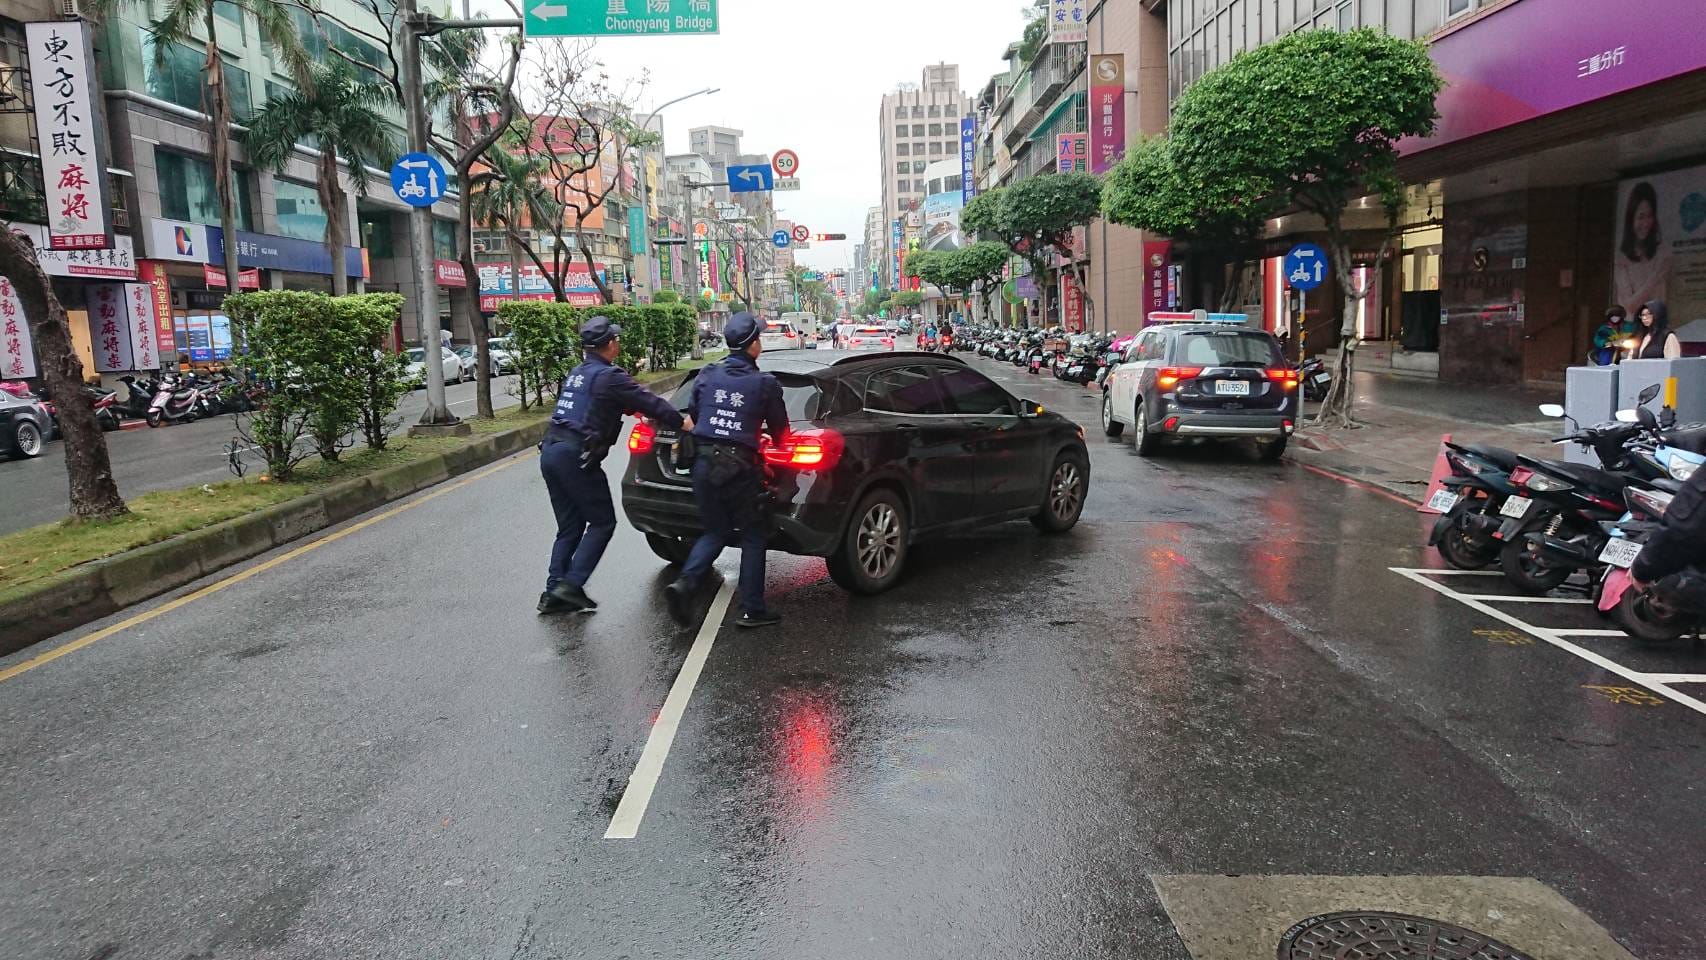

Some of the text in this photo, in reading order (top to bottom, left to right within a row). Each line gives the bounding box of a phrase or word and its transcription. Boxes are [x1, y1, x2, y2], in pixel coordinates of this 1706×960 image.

[605, 15, 713, 32] Chongyang Bridge
[1576, 46, 1625, 78] 三重分行
[1103, 94, 1113, 137] 兆豐銀行
[778, 158, 793, 168] 50
[54, 235, 105, 248] 三重直營店
[1153, 270, 1163, 307] 兆豐銀行
[97, 286, 122, 369] 電動麻將桌
[133, 286, 152, 367] 電動麻將桌
[714, 389, 745, 407] 警察
[716, 409, 737, 418] POLICE
